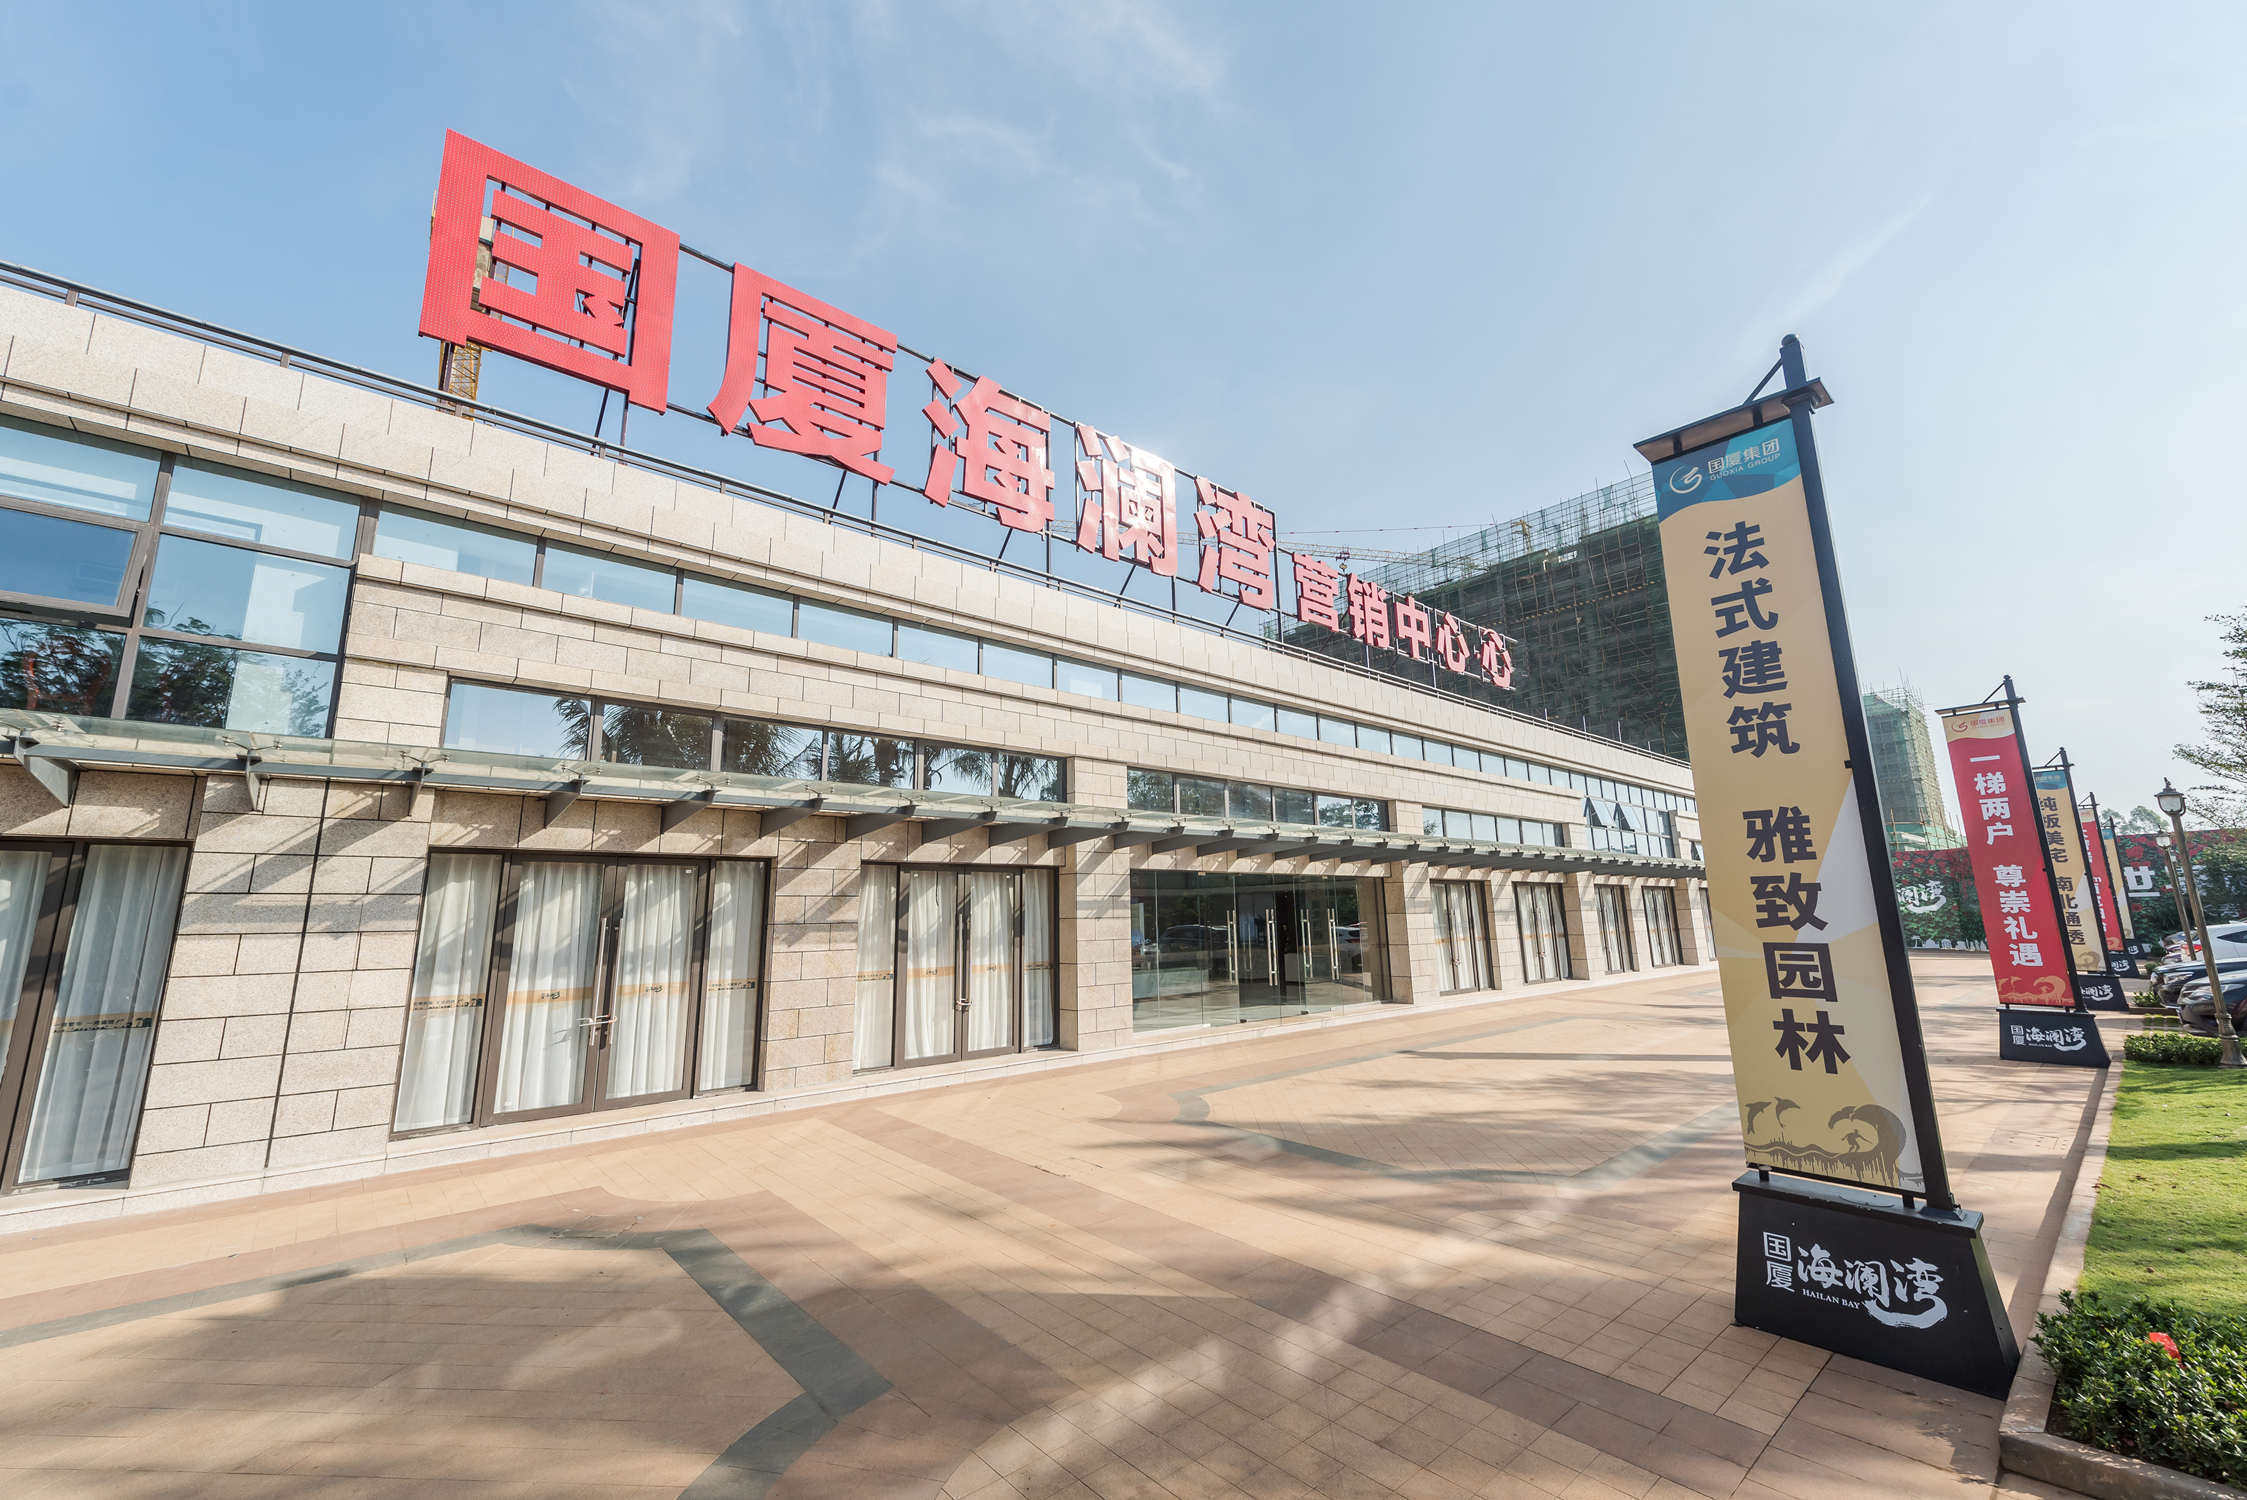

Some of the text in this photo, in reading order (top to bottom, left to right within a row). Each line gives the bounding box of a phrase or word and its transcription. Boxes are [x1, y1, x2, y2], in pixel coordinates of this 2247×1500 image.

[418, 128, 1275, 612] 国厦海澜湾
[1707, 437, 1780, 474] 国厦集团
[1709, 452, 1781, 481] GUOXIA GROUP
[1703, 520, 1851, 1075] 法式建筑 雅致园林
[1969, 754, 2014, 846] 一梯两户
[1992, 864, 2044, 967] 尊崇礼遇
[1763, 1231, 1795, 1293] 国厦
[1797, 1243, 1949, 1329] 海澜湾
[1802, 1287, 1861, 1310] HAILAN BAY
